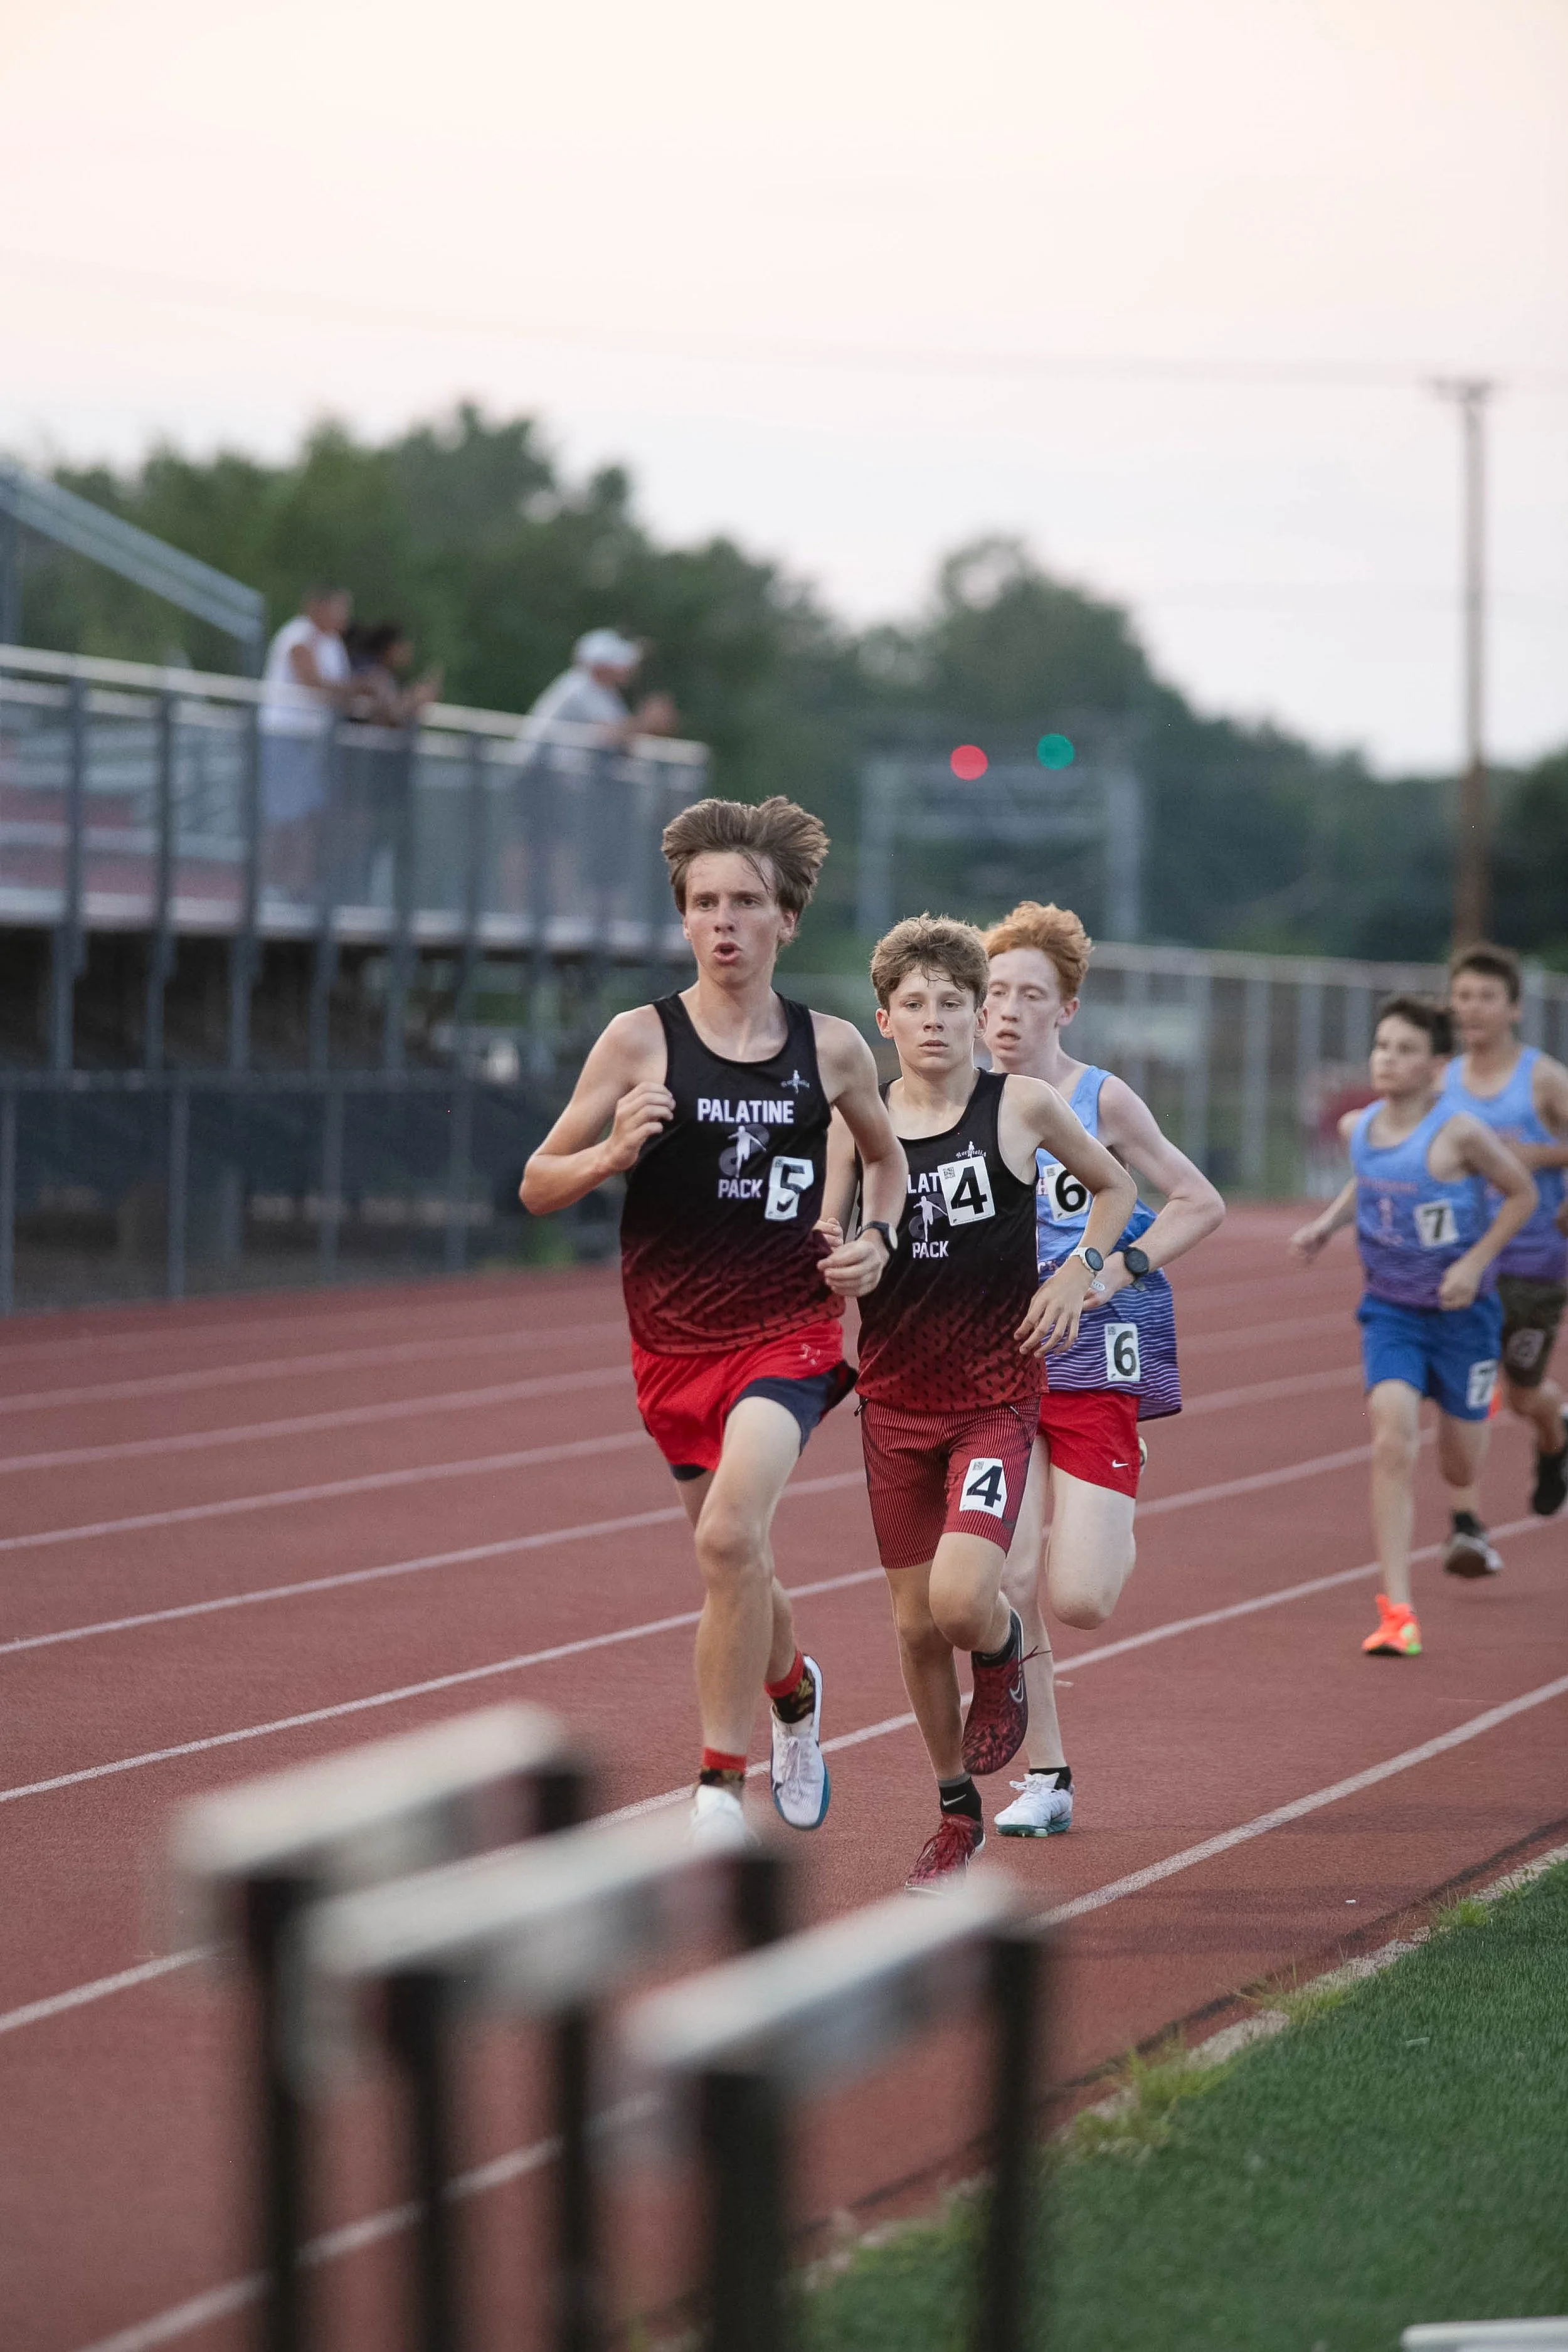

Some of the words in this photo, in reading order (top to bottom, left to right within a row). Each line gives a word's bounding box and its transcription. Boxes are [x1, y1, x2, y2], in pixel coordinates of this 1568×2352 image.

[697, 1098, 794, 1123] PALATINE
[718, 1179, 763, 1199] PACK
[777, 1163, 805, 1212] 5
[950, 1166, 988, 1215] 4
[1056, 1169, 1087, 1212] 6
[1422, 1207, 1448, 1239] 7
[912, 1241, 949, 1259] PACK
[1114, 1330, 1136, 1377] 6
[966, 1465, 1003, 1508] 4
